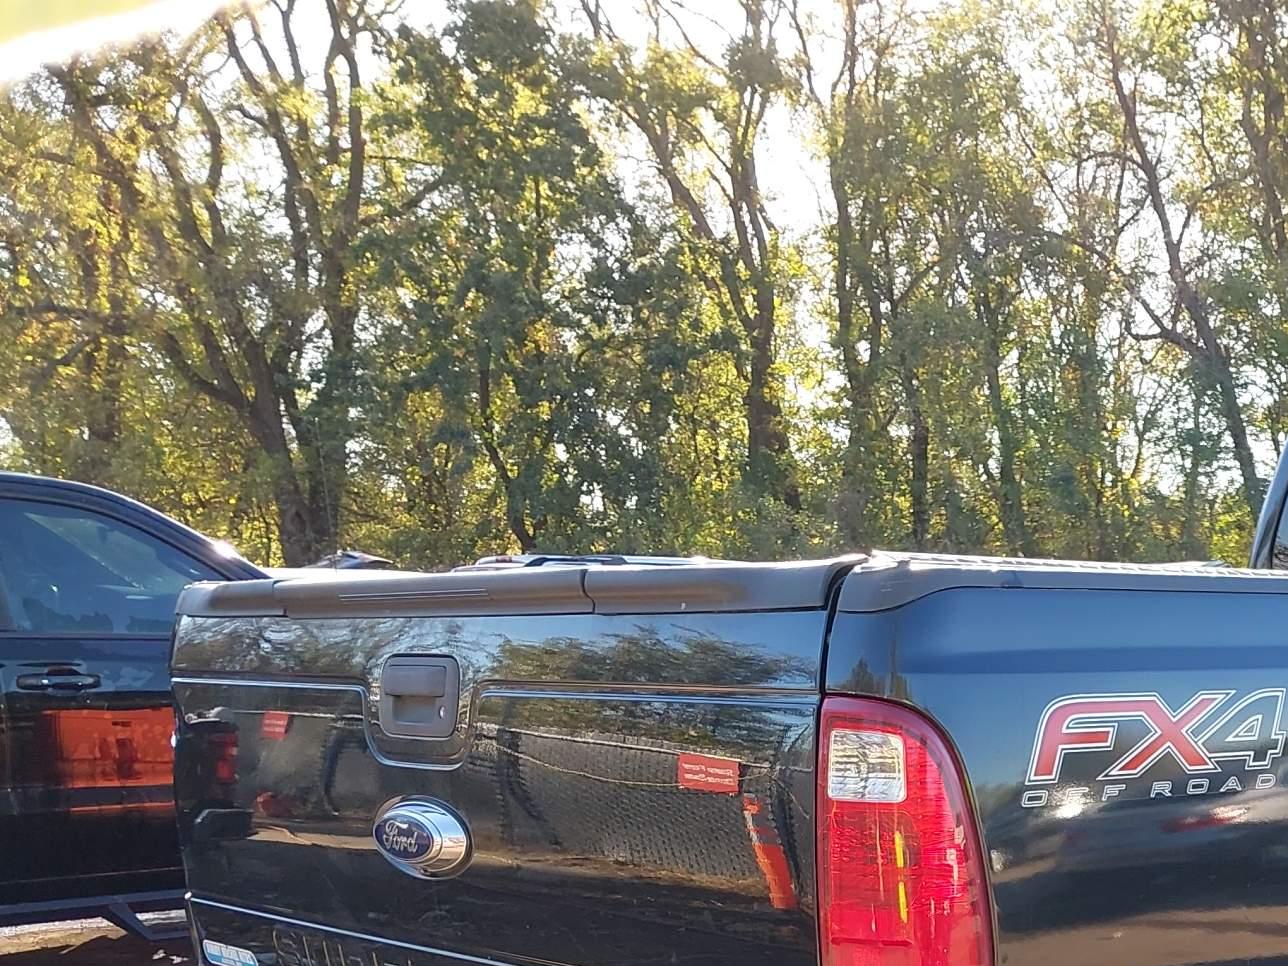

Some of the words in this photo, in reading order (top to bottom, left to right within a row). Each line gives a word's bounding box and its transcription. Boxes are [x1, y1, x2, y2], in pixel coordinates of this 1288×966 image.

[1025, 688, 1287, 785] FX4
[1021, 784, 1127, 808] OFF
[1150, 773, 1277, 798] ROAD
[383, 820, 419, 853] Ford
